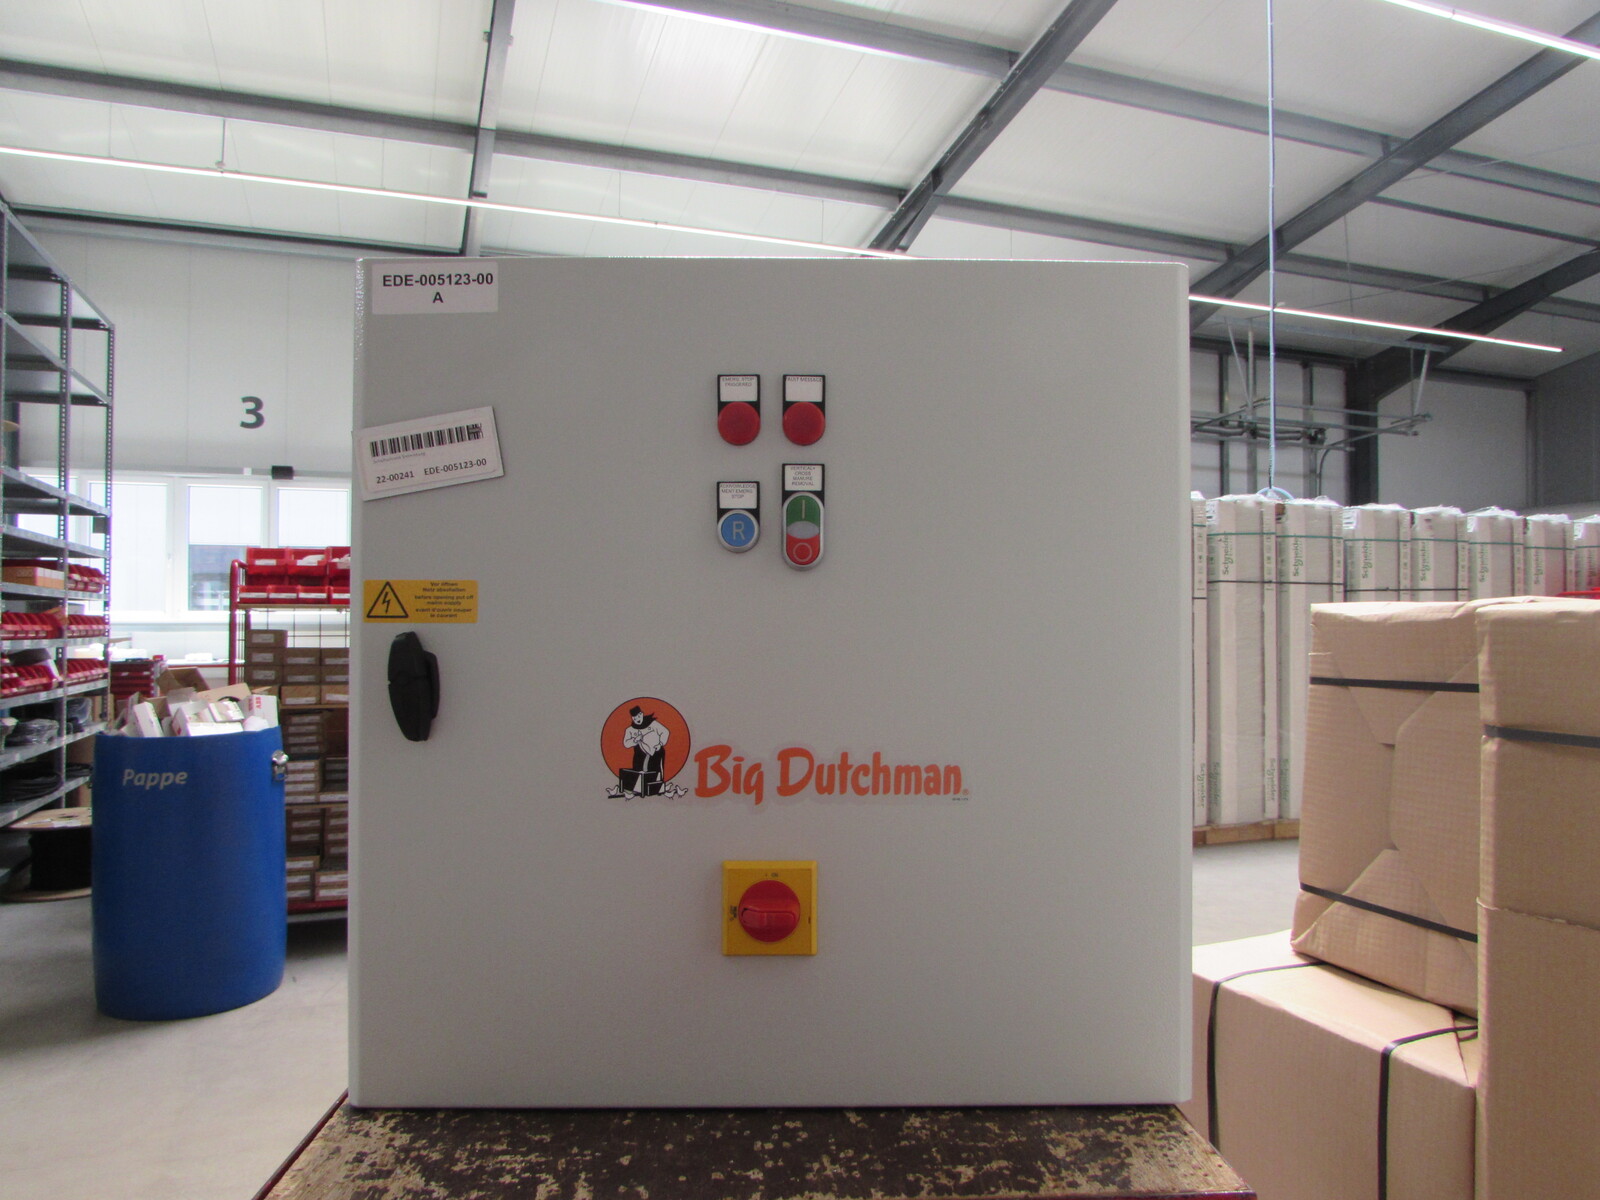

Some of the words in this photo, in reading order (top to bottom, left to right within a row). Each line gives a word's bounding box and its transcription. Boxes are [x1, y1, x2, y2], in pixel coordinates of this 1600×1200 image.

[382, 273, 494, 287] EDE-005123-00
[432, 292, 443, 303] A
[239, 395, 264, 429] 3
[376, 471, 414, 484] 22-00241
[424, 458, 487, 476] EDE-005123-00
[732, 521, 745, 540] R
[122, 768, 189, 791] Pappe
[694, 744, 764, 806] Big
[776, 747, 962, 797] Dutchman
